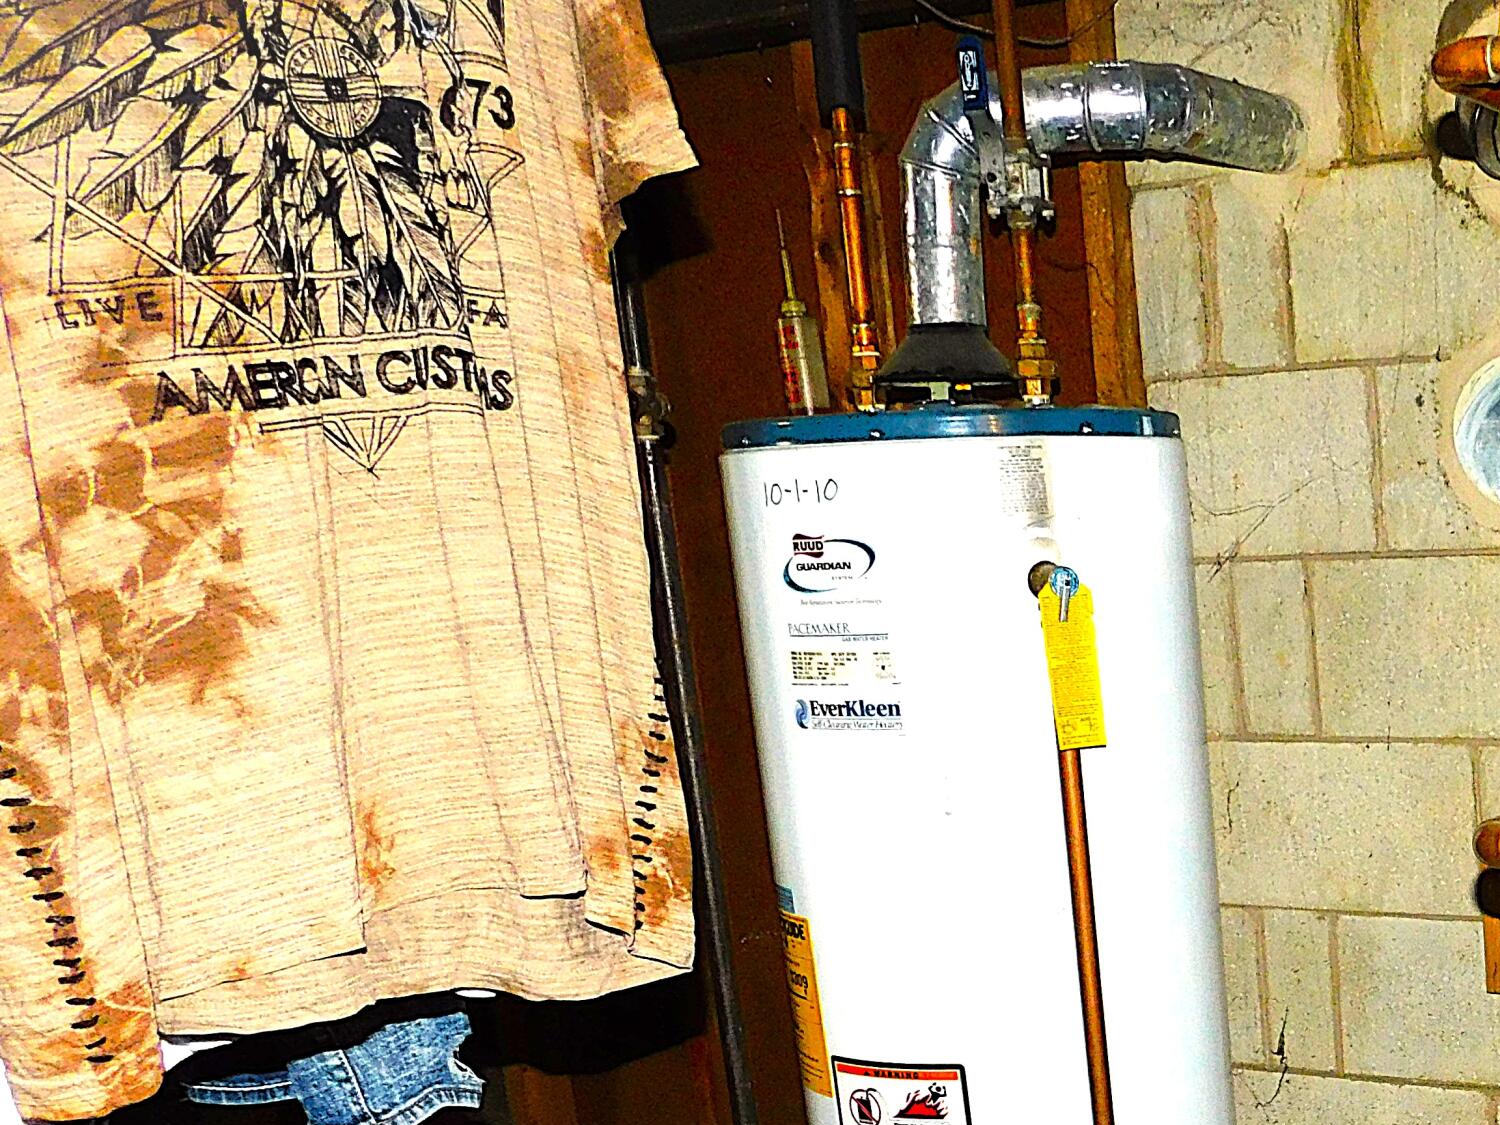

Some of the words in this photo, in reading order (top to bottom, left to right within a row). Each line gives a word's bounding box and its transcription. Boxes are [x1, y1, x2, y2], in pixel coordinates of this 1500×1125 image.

[54, 289, 163, 330] LIVE
[764, 478, 838, 507] 10-1-10
[793, 541, 824, 552] RUUD
[796, 562, 852, 571] GUARDIAN
[788, 623, 850, 634] PACEMAKER
[809, 700, 901, 717] EverKleen
